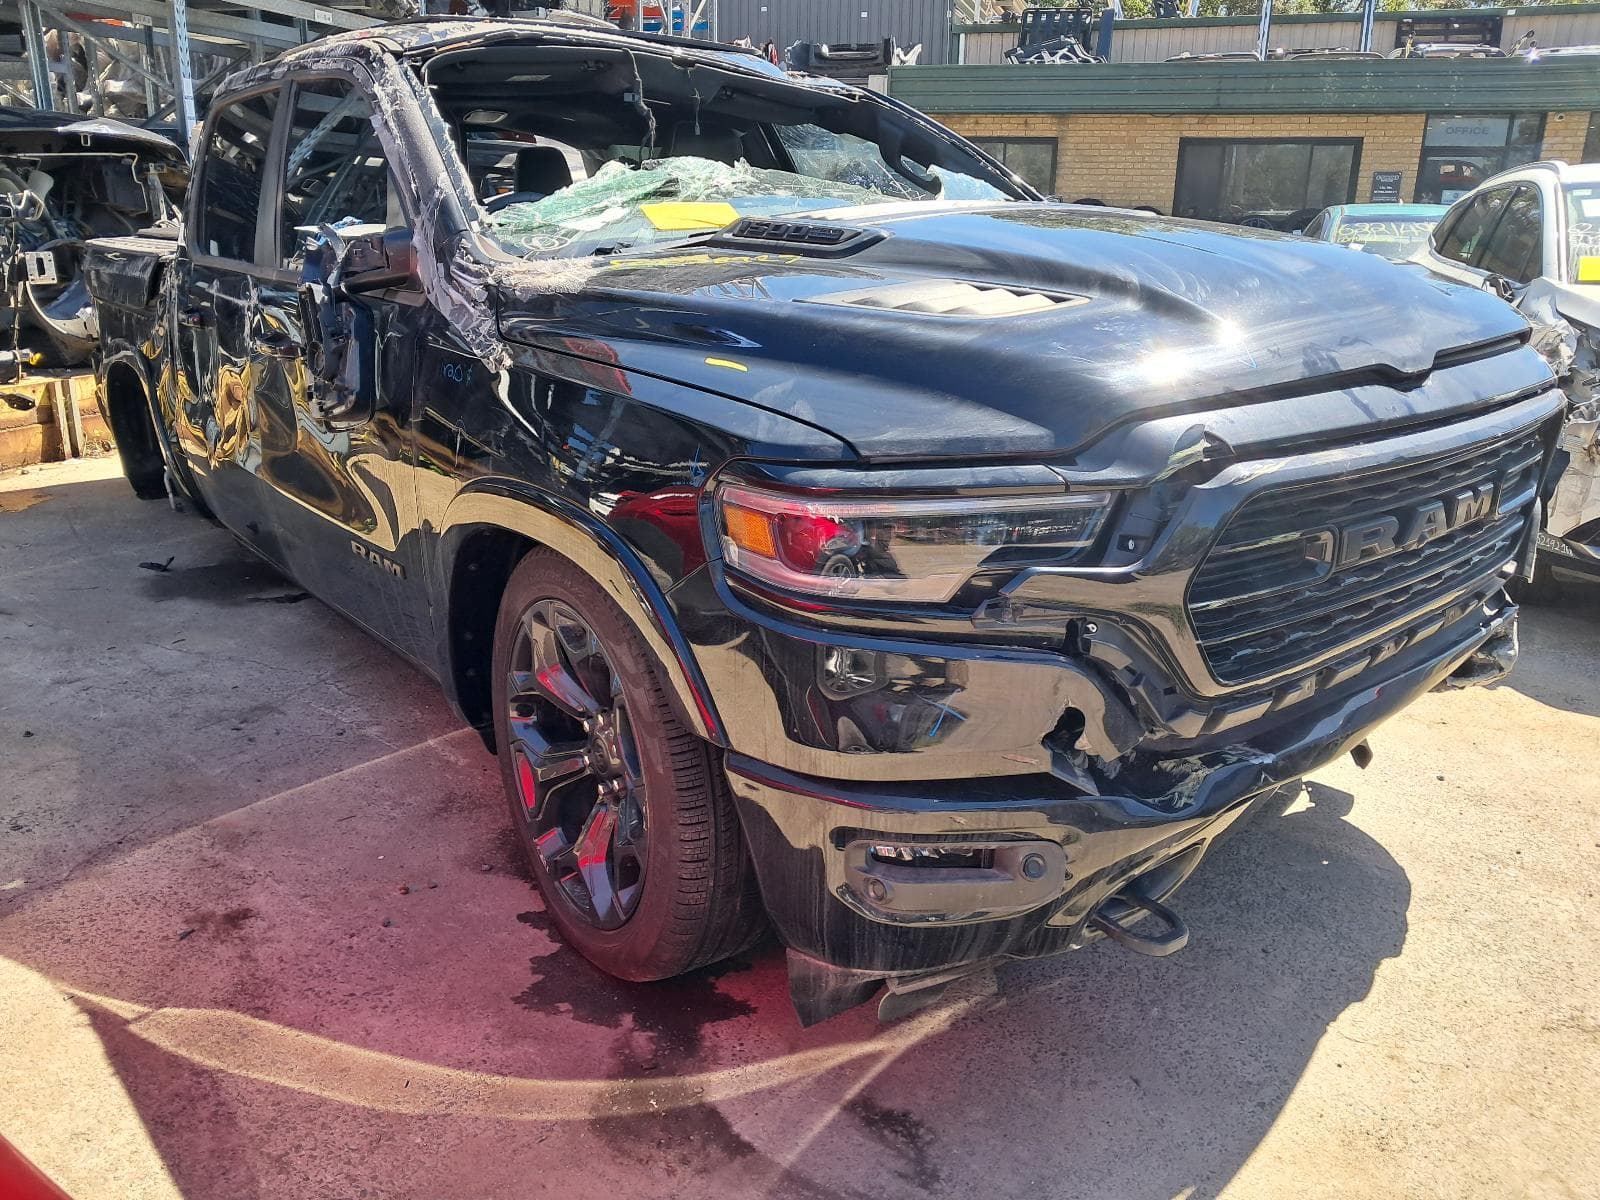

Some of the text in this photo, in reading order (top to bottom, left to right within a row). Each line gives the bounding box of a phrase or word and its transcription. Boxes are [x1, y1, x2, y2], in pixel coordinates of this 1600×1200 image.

[1445, 126, 1490, 136] OFFICE
[1340, 482, 1494, 564] RAM
[351, 540, 404, 579] RAM
